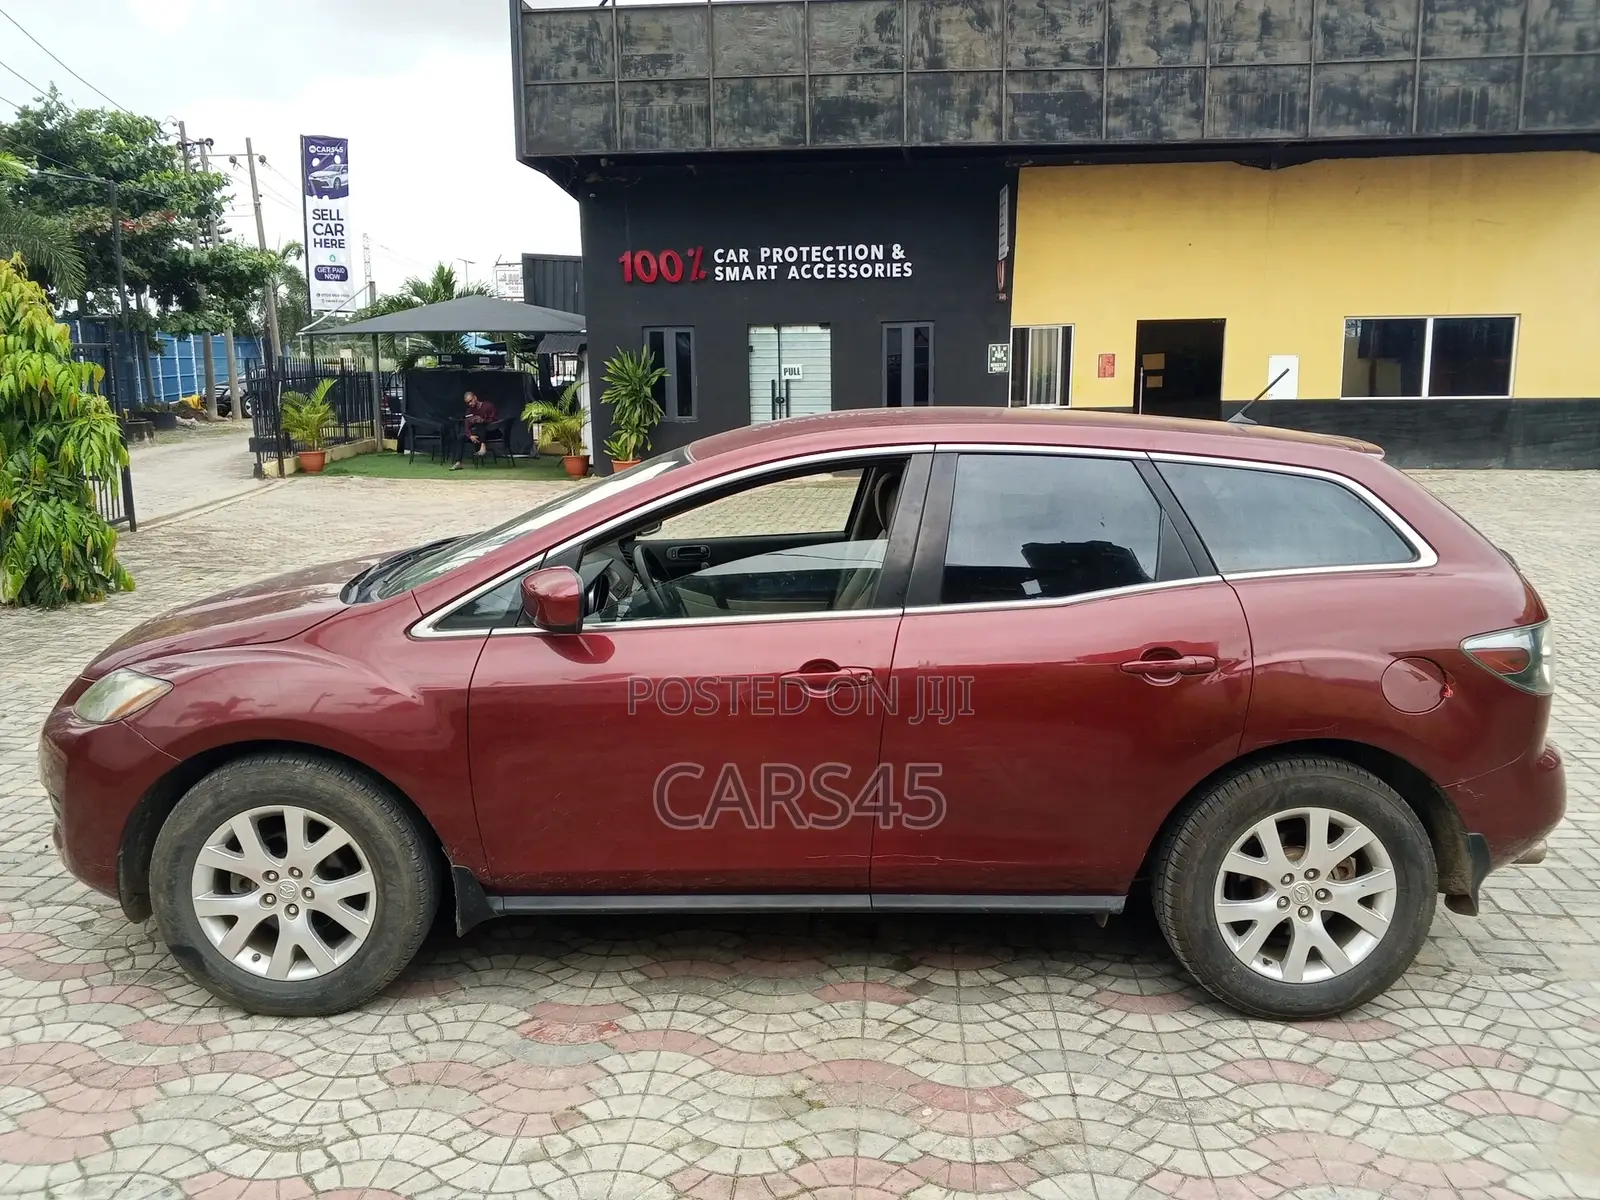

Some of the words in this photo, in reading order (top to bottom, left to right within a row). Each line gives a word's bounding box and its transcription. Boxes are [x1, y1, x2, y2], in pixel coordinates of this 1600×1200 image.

[312, 208, 344, 221] SELL
[312, 222, 345, 236] CAR
[313, 238, 346, 249] HERE
[618, 245, 708, 284] 100%
[713, 248, 749, 264] CAR
[760, 243, 884, 263] PROTECTION
[891, 243, 905, 260] &
[714, 264, 778, 282] SMART
[787, 261, 913, 280] ACCESSORIES
[783, 366, 801, 376] PULL
